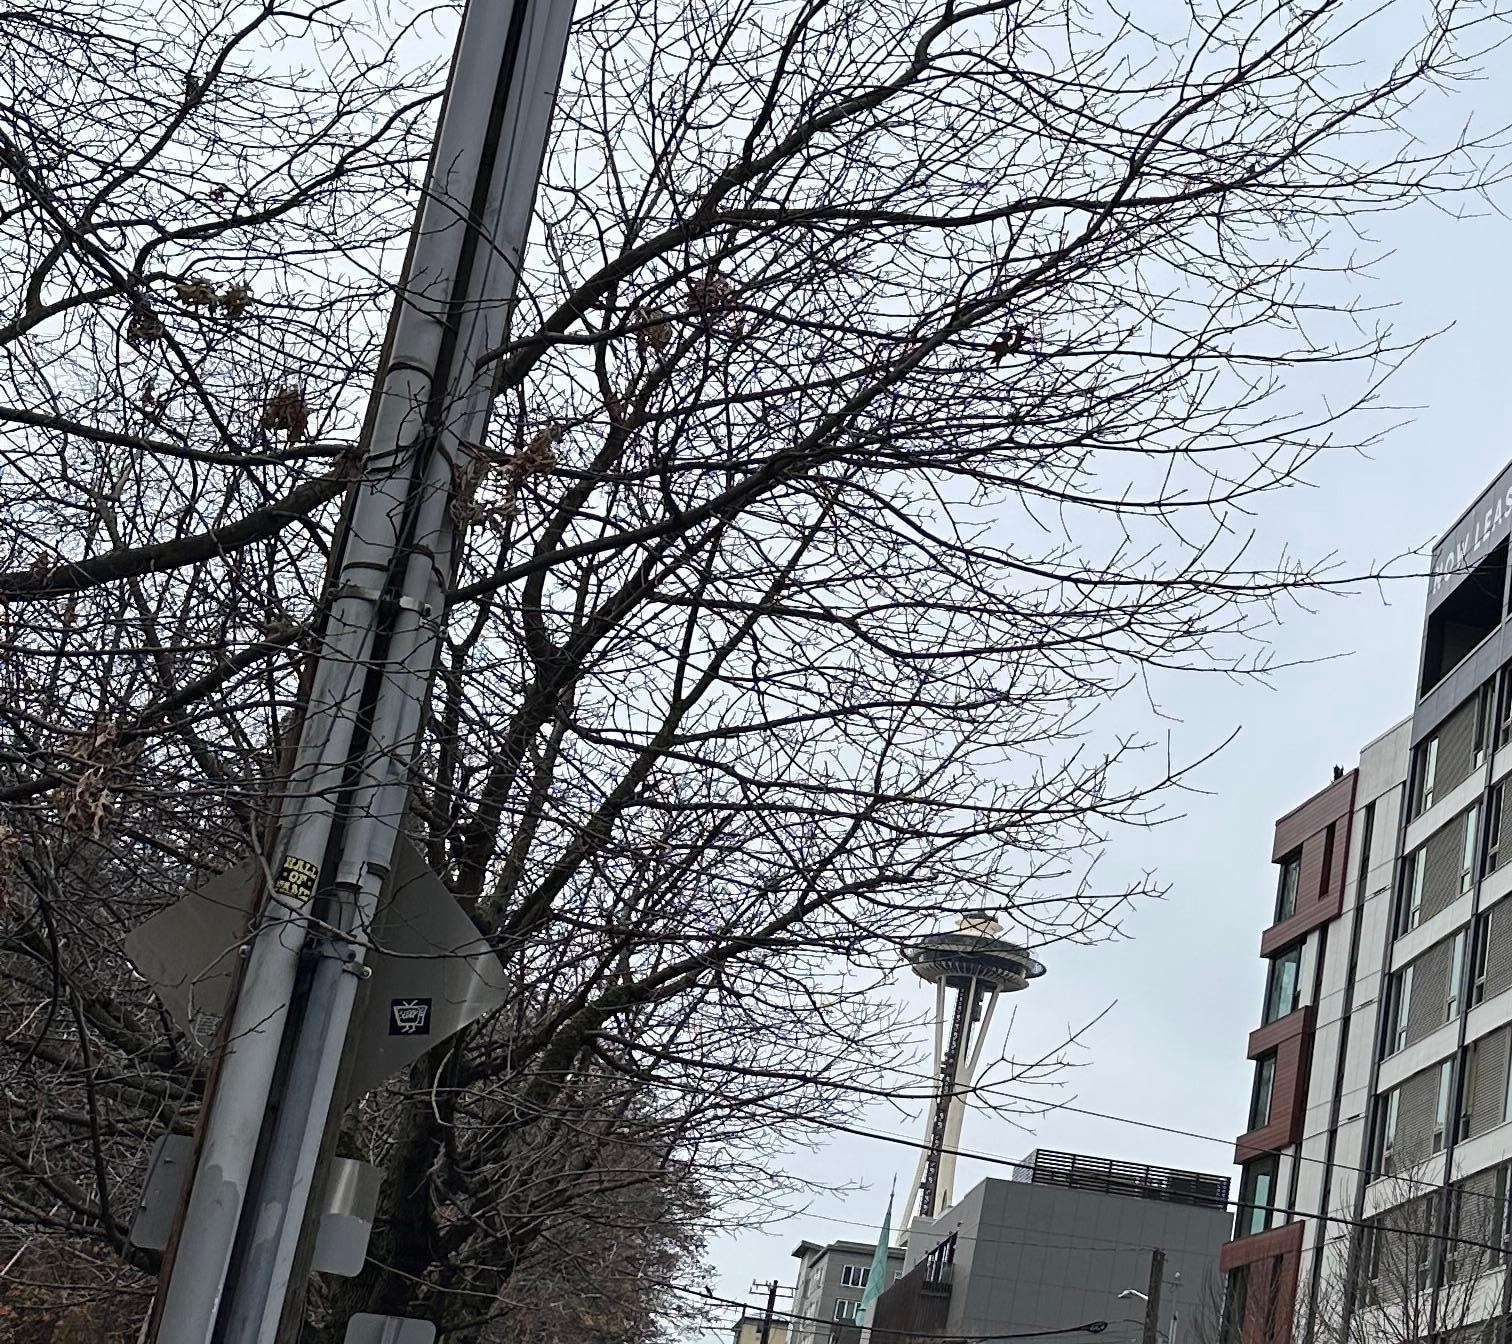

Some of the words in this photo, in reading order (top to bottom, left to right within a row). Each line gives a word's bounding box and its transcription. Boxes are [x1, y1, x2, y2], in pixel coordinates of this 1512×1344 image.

[1433, 533, 1470, 594] NOW
[284, 856, 317, 880] HALL
[289, 871, 308, 885] OF
